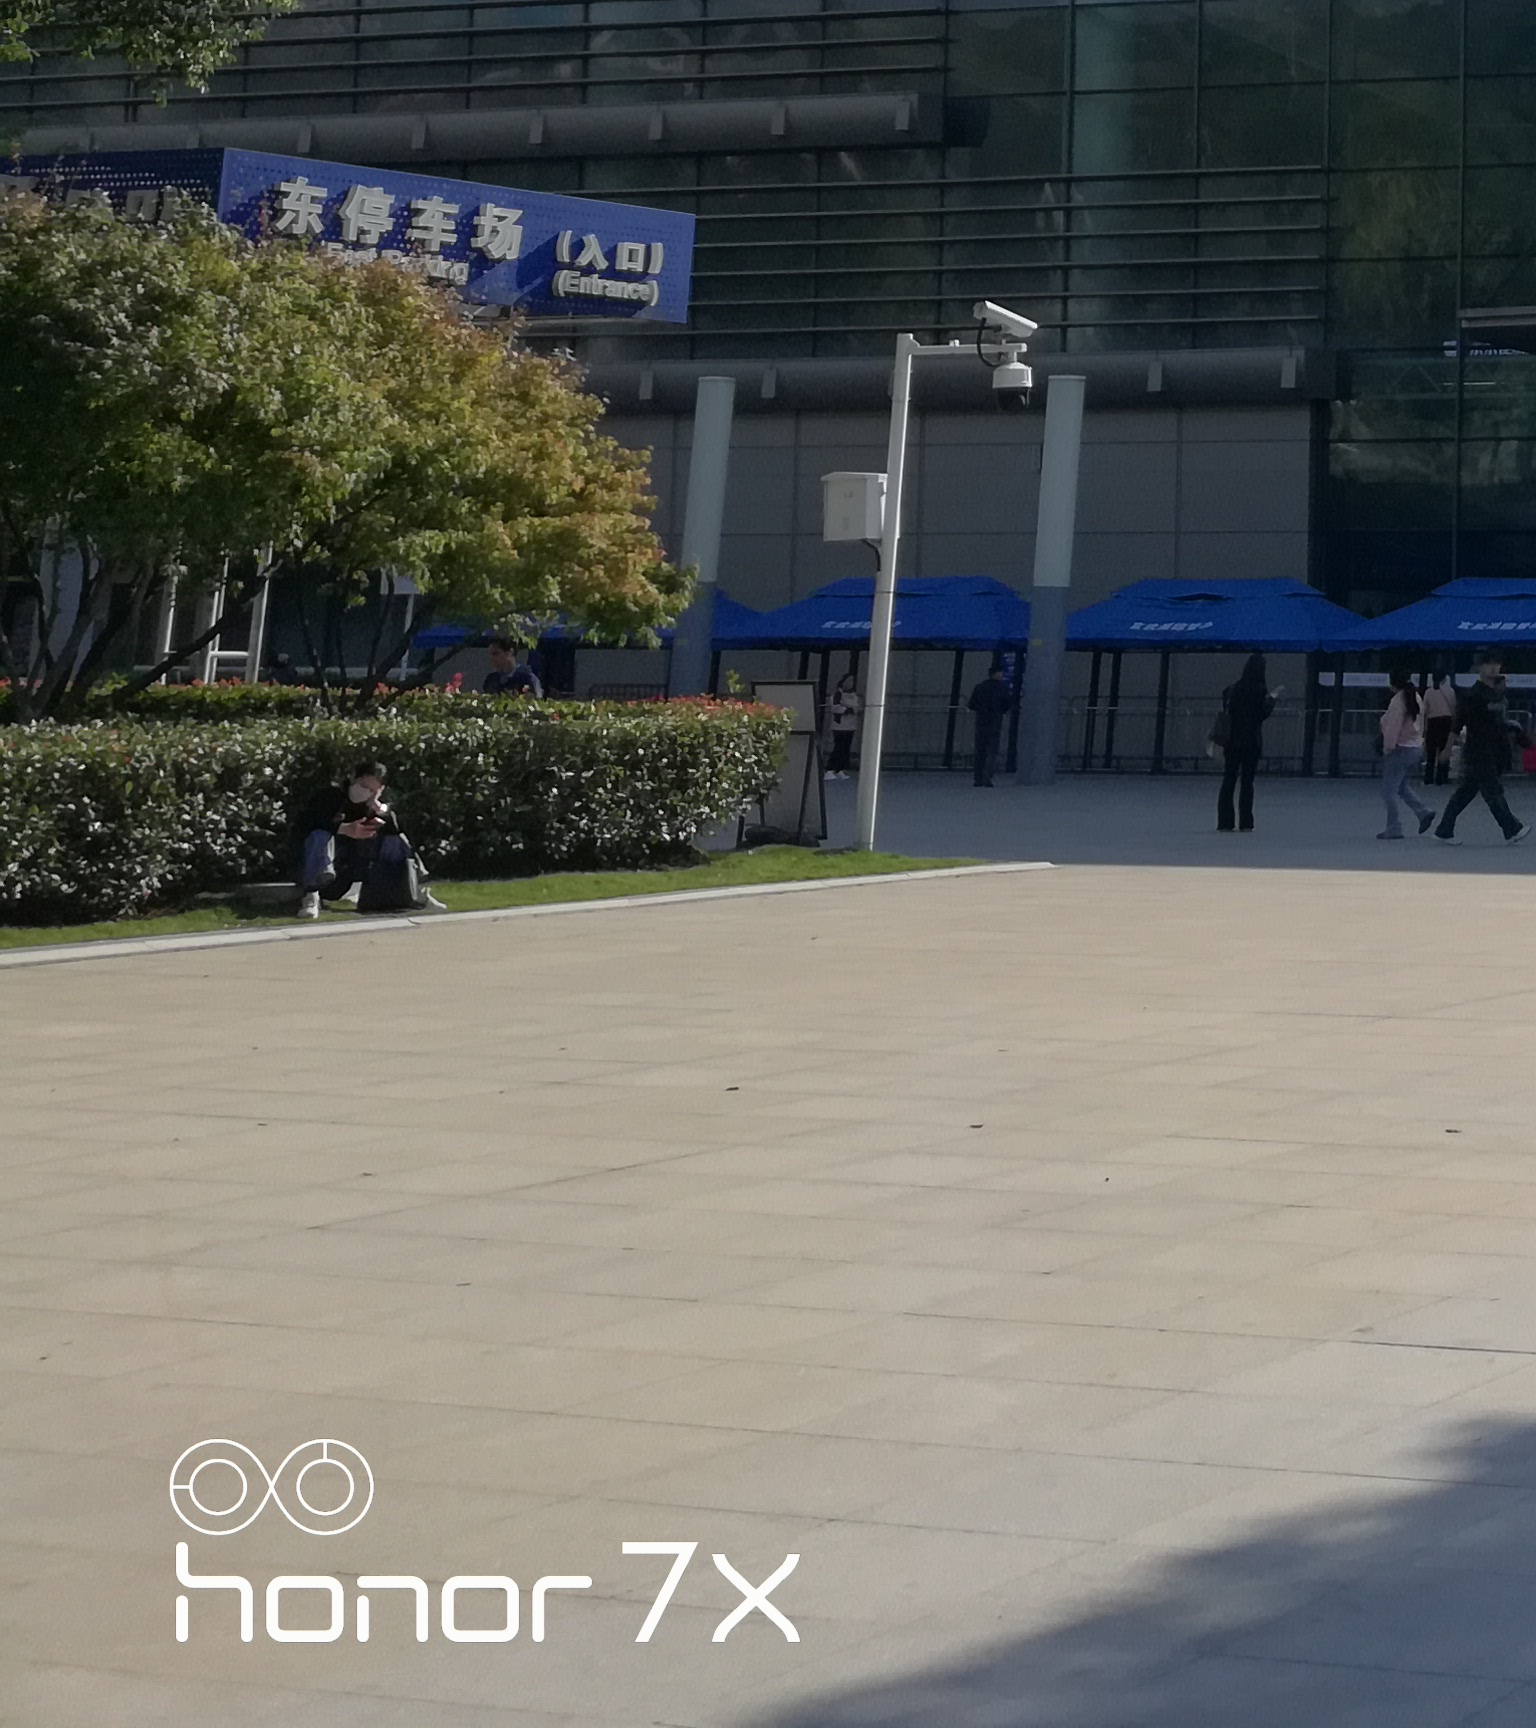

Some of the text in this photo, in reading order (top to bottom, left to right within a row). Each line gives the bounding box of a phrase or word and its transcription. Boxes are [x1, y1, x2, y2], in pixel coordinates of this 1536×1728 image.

[273, 176, 665, 275] 东停车场 (入口)
[551, 269, 660, 307] (Entrance)
